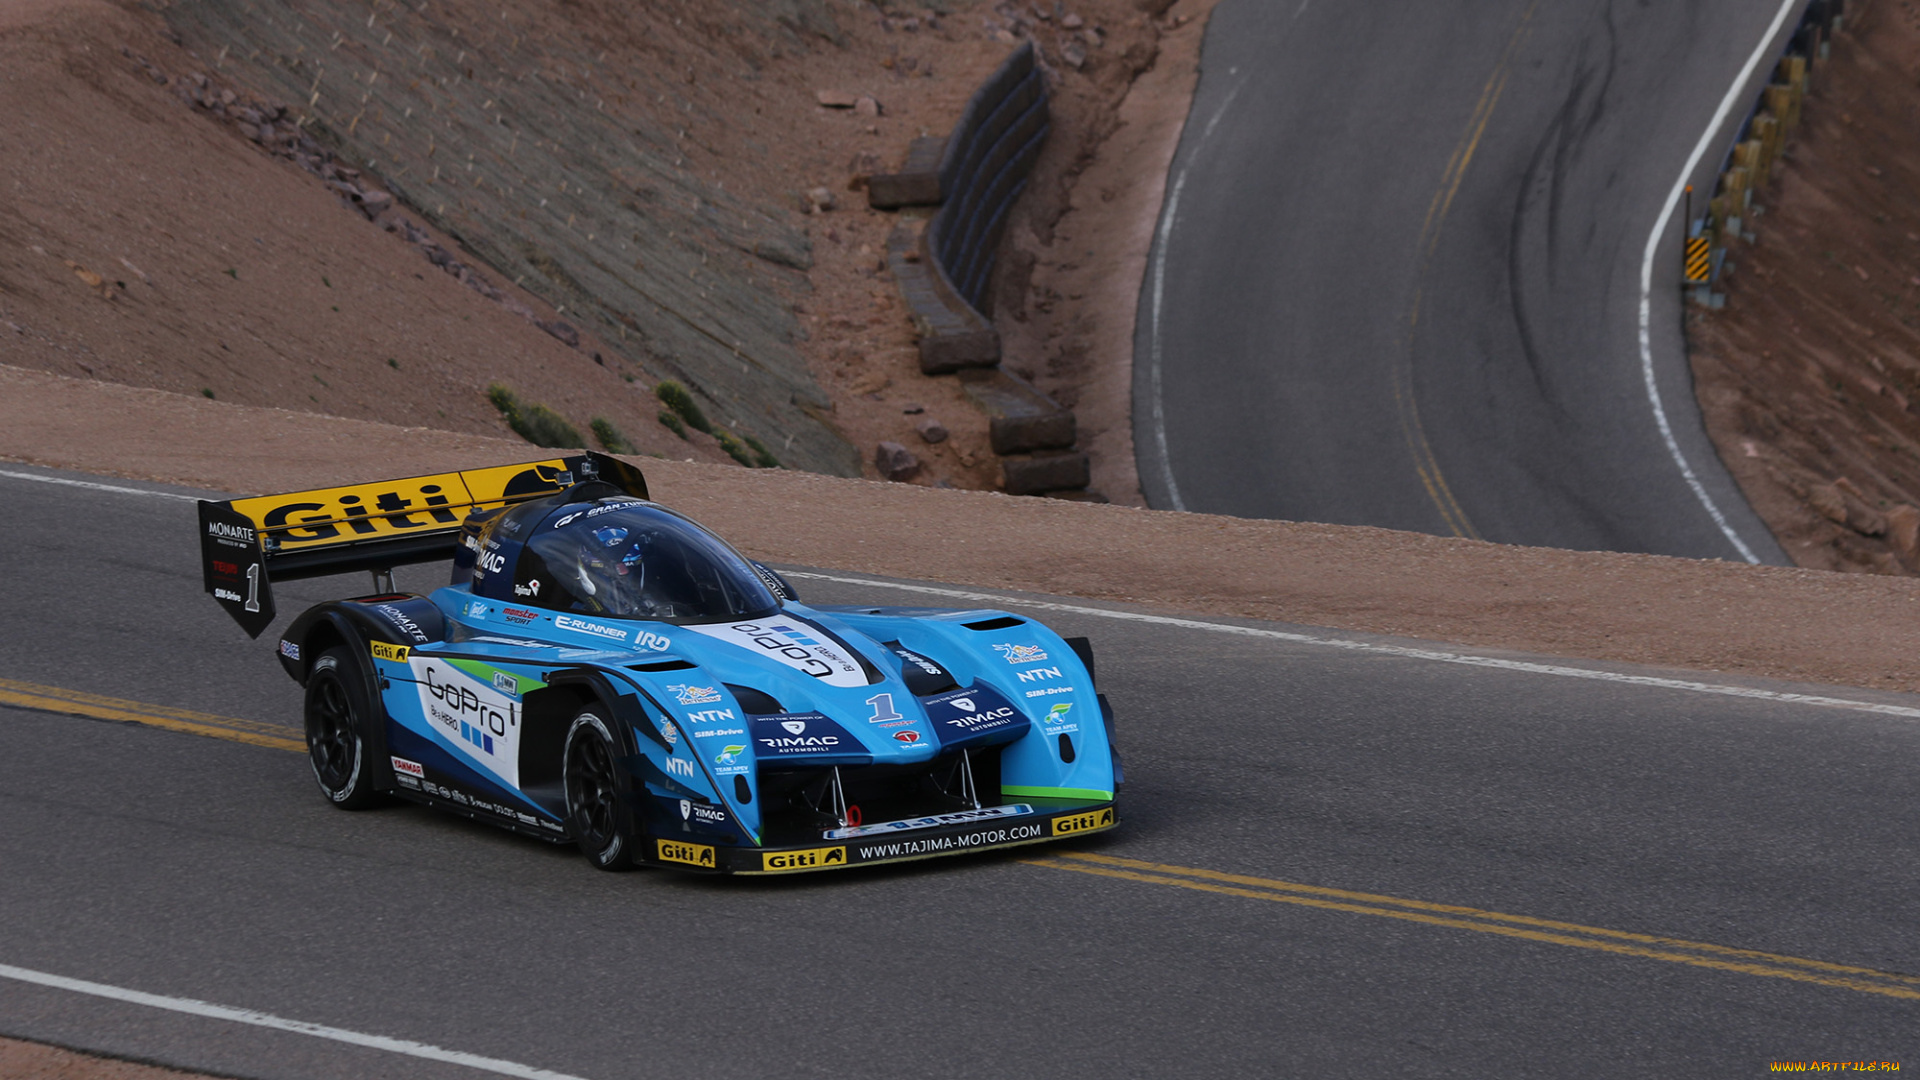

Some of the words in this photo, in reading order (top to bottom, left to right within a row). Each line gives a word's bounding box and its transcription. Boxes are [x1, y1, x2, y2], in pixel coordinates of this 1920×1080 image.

[264, 485, 459, 542] Giti
[587, 503, 620, 515] GRAN
[208, 522, 255, 541] MONARTE
[245, 563, 260, 613] 1
[502, 607, 540, 620] monster
[505, 616, 532, 625] SPORT
[377, 604, 429, 642] MONARTE
[555, 615, 628, 639] E-RUNNER
[634, 630, 671, 652] IRD
[373, 644, 393, 659] Giti
[731, 624, 834, 678] GoPro
[1016, 666, 1063, 683] NTN
[952, 691, 970, 699] POWER
[1026, 686, 1074, 698] SIM-Drive
[426, 667, 505, 737] GoPro
[866, 693, 904, 723] 1
[687, 708, 735, 724] NTN
[946, 707, 1015, 729] RIMAC
[694, 728, 744, 738] SIM-Drive
[970, 718, 1011, 732] AUTOMOBILI
[758, 736, 839, 748] RIMAC
[393, 759, 423, 775] YANMAR
[666, 756, 693, 778] NTN
[693, 807, 725, 821] RIMAC
[1056, 815, 1095, 833] Giti
[860, 824, 1042, 859] WWW.TAJIMA-MOTOR.COM
[661, 843, 694, 861] Giti
[768, 853, 816, 868] Giti
